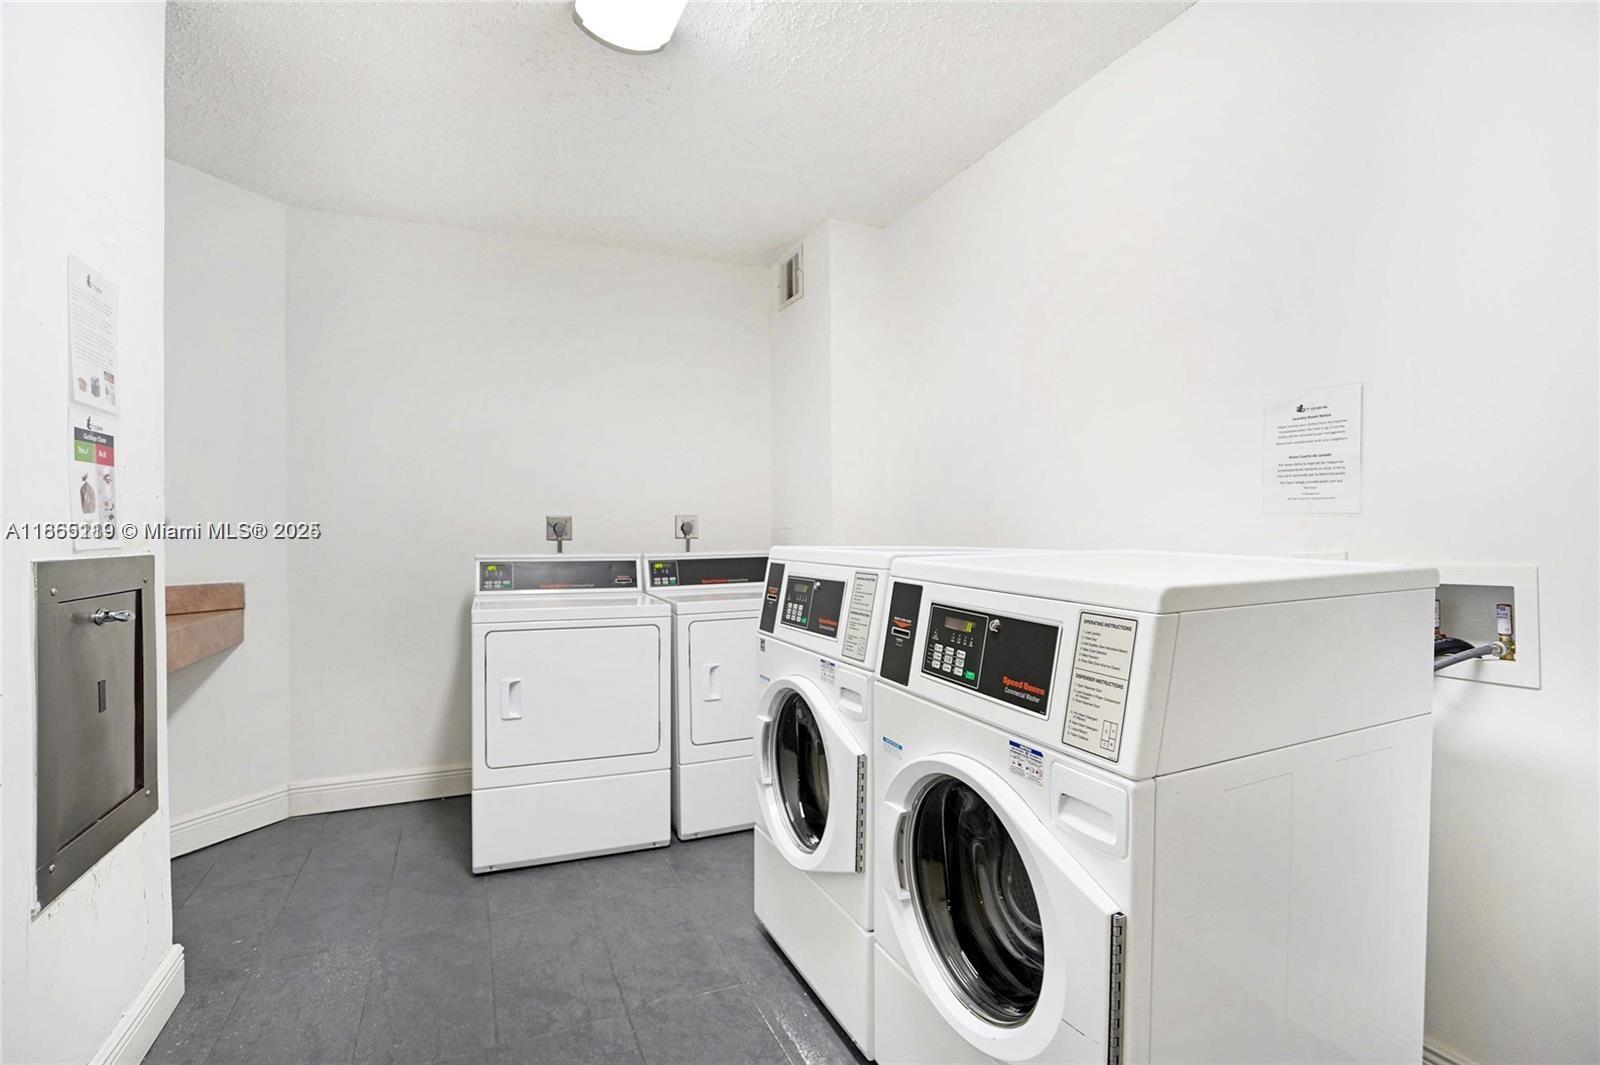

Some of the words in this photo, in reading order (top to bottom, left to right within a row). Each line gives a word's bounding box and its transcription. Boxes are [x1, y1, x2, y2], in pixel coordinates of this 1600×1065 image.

[1083, 619, 1104, 628] OPERATING
[1104, 621, 1132, 632] INSTRUCTIONS
[1003, 676, 1023, 690] Speed
[1023, 682, 1046, 697] Queen
[1075, 672, 1096, 682] DISPENSER
[1096, 677, 1124, 690] INSTRUCTIONS
[1004, 686, 1026, 699] Commercial
[1026, 693, 1041, 703] Washer
